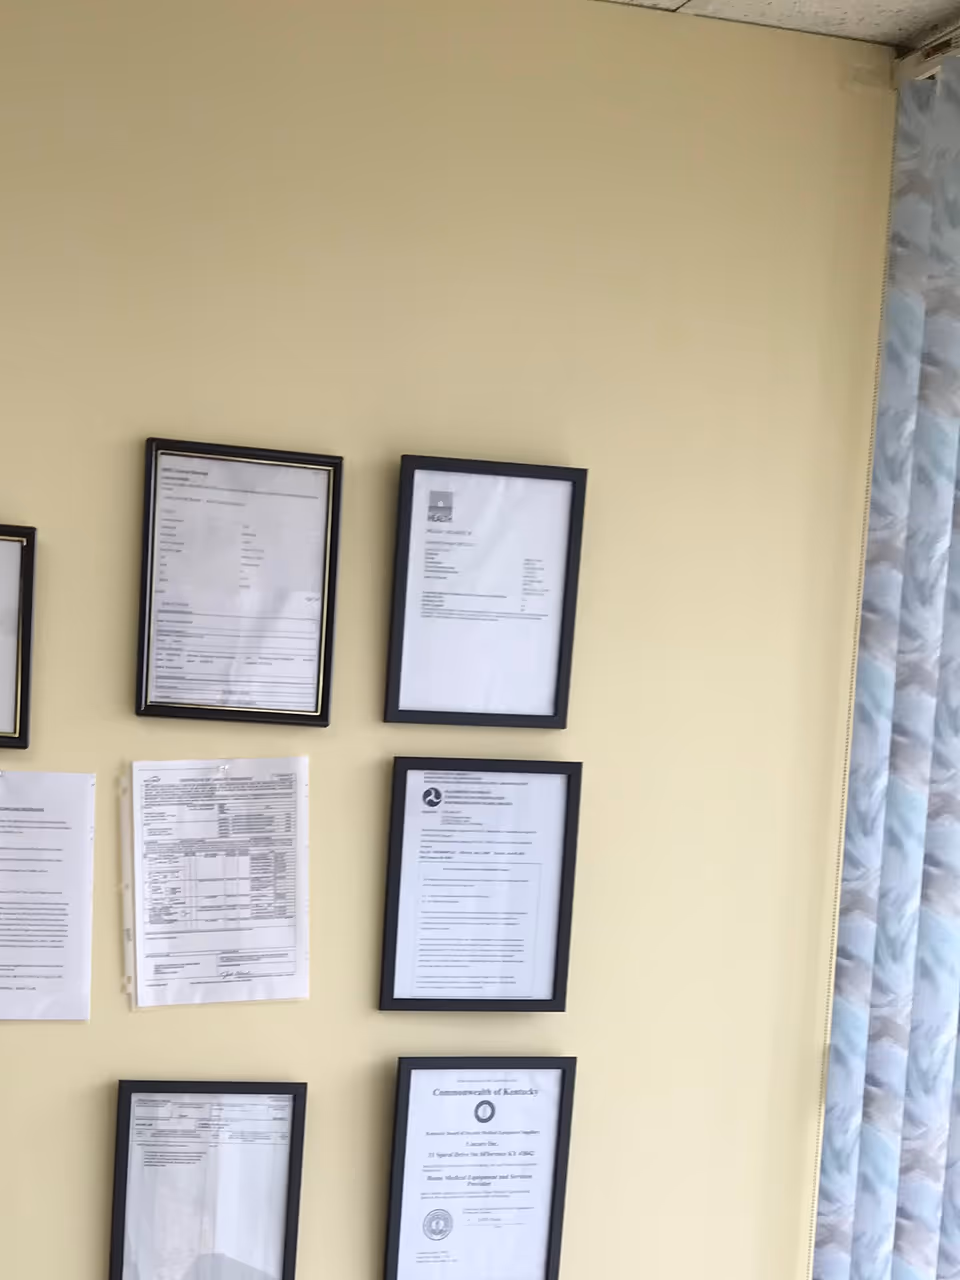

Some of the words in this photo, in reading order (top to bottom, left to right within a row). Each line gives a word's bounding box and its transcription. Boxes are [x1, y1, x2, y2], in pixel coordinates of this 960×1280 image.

[432, 1088, 492, 1096] Commonwealth
[493, 1088, 502, 1096] of
[503, 1088, 539, 1097] Kentucky
